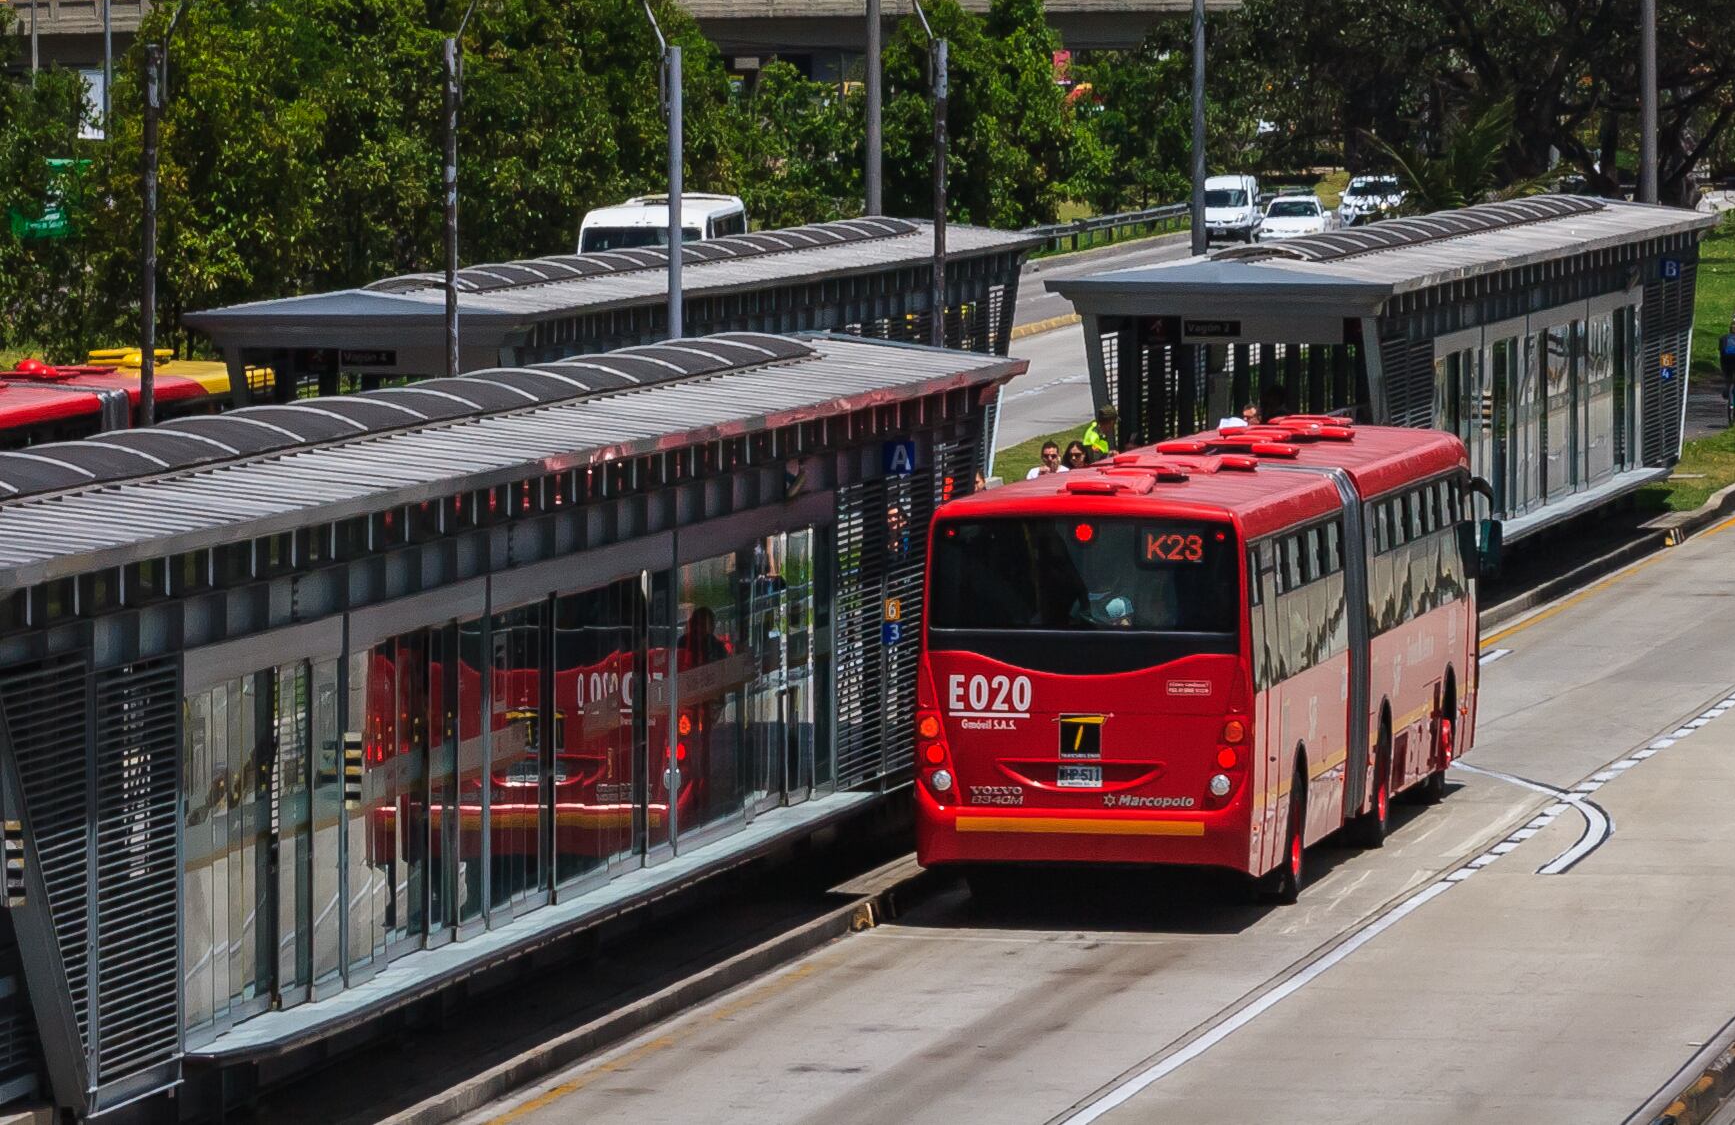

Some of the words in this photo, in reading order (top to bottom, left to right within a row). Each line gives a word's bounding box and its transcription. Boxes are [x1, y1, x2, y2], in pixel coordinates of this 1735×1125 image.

[1665, 260, 1676, 276] B
[890, 444, 912, 471] A
[1146, 534, 1203, 561] K23
[888, 601, 897, 618] 6
[890, 624, 900, 641] 3
[949, 674, 1032, 712] E020
[969, 785, 1023, 795] VOLVO
[1118, 794, 1195, 807] Marcopolo
